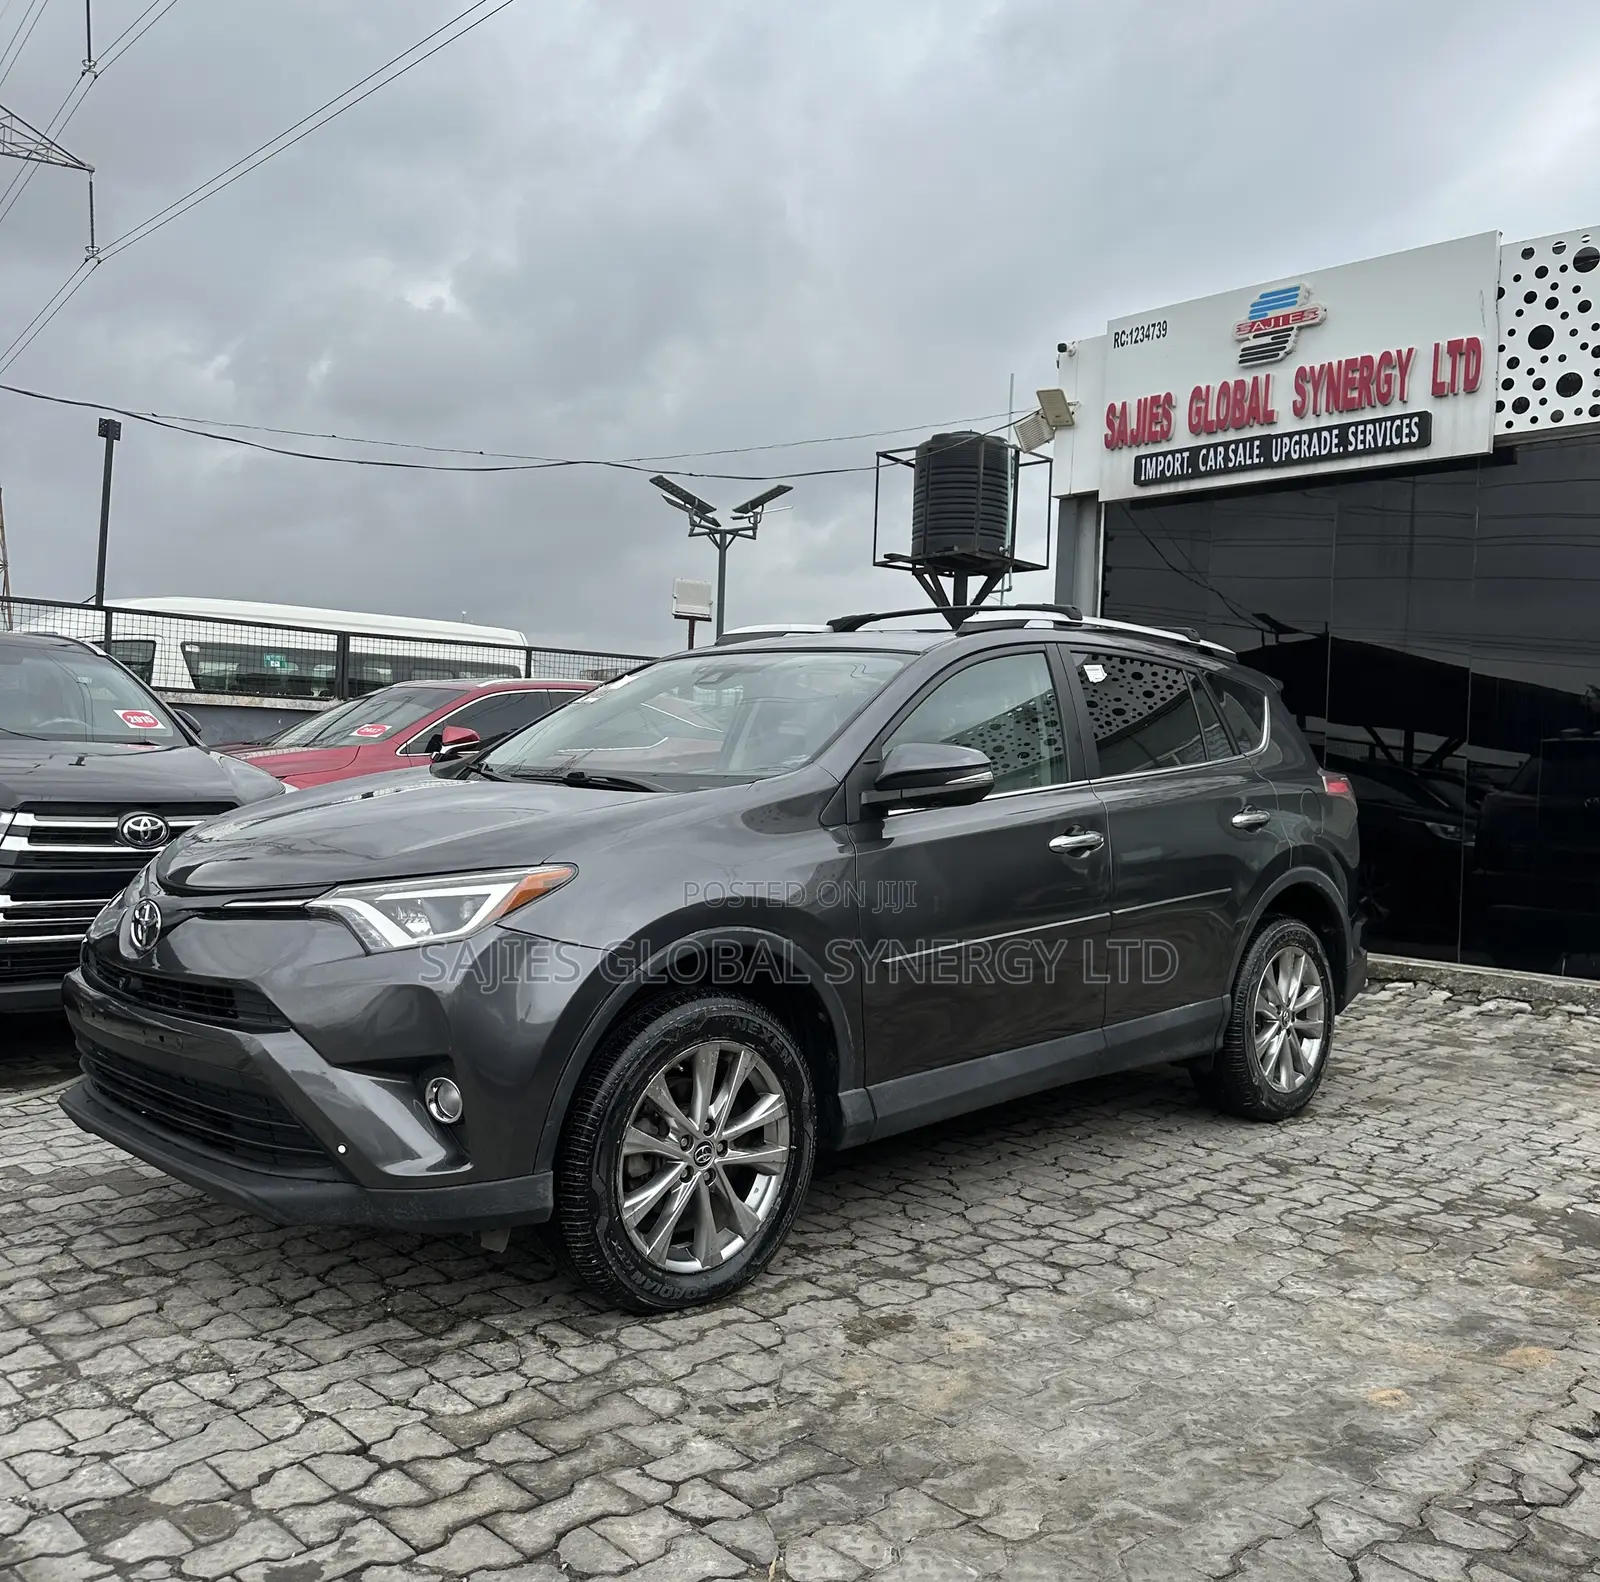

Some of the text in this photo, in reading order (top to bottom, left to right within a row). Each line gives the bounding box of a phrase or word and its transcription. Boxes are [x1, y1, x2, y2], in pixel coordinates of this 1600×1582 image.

[1113, 320, 1168, 349] RC:1234739
[1236, 307, 1319, 336] SAJIES
[1104, 336, 1483, 450] SAJIES GLOBAL SYNERGY LTD
[1140, 416, 1420, 481] IMPORT. CAR SALE. UPGRADE. SERVICES
[732, 1018, 793, 1067] NEXEN
